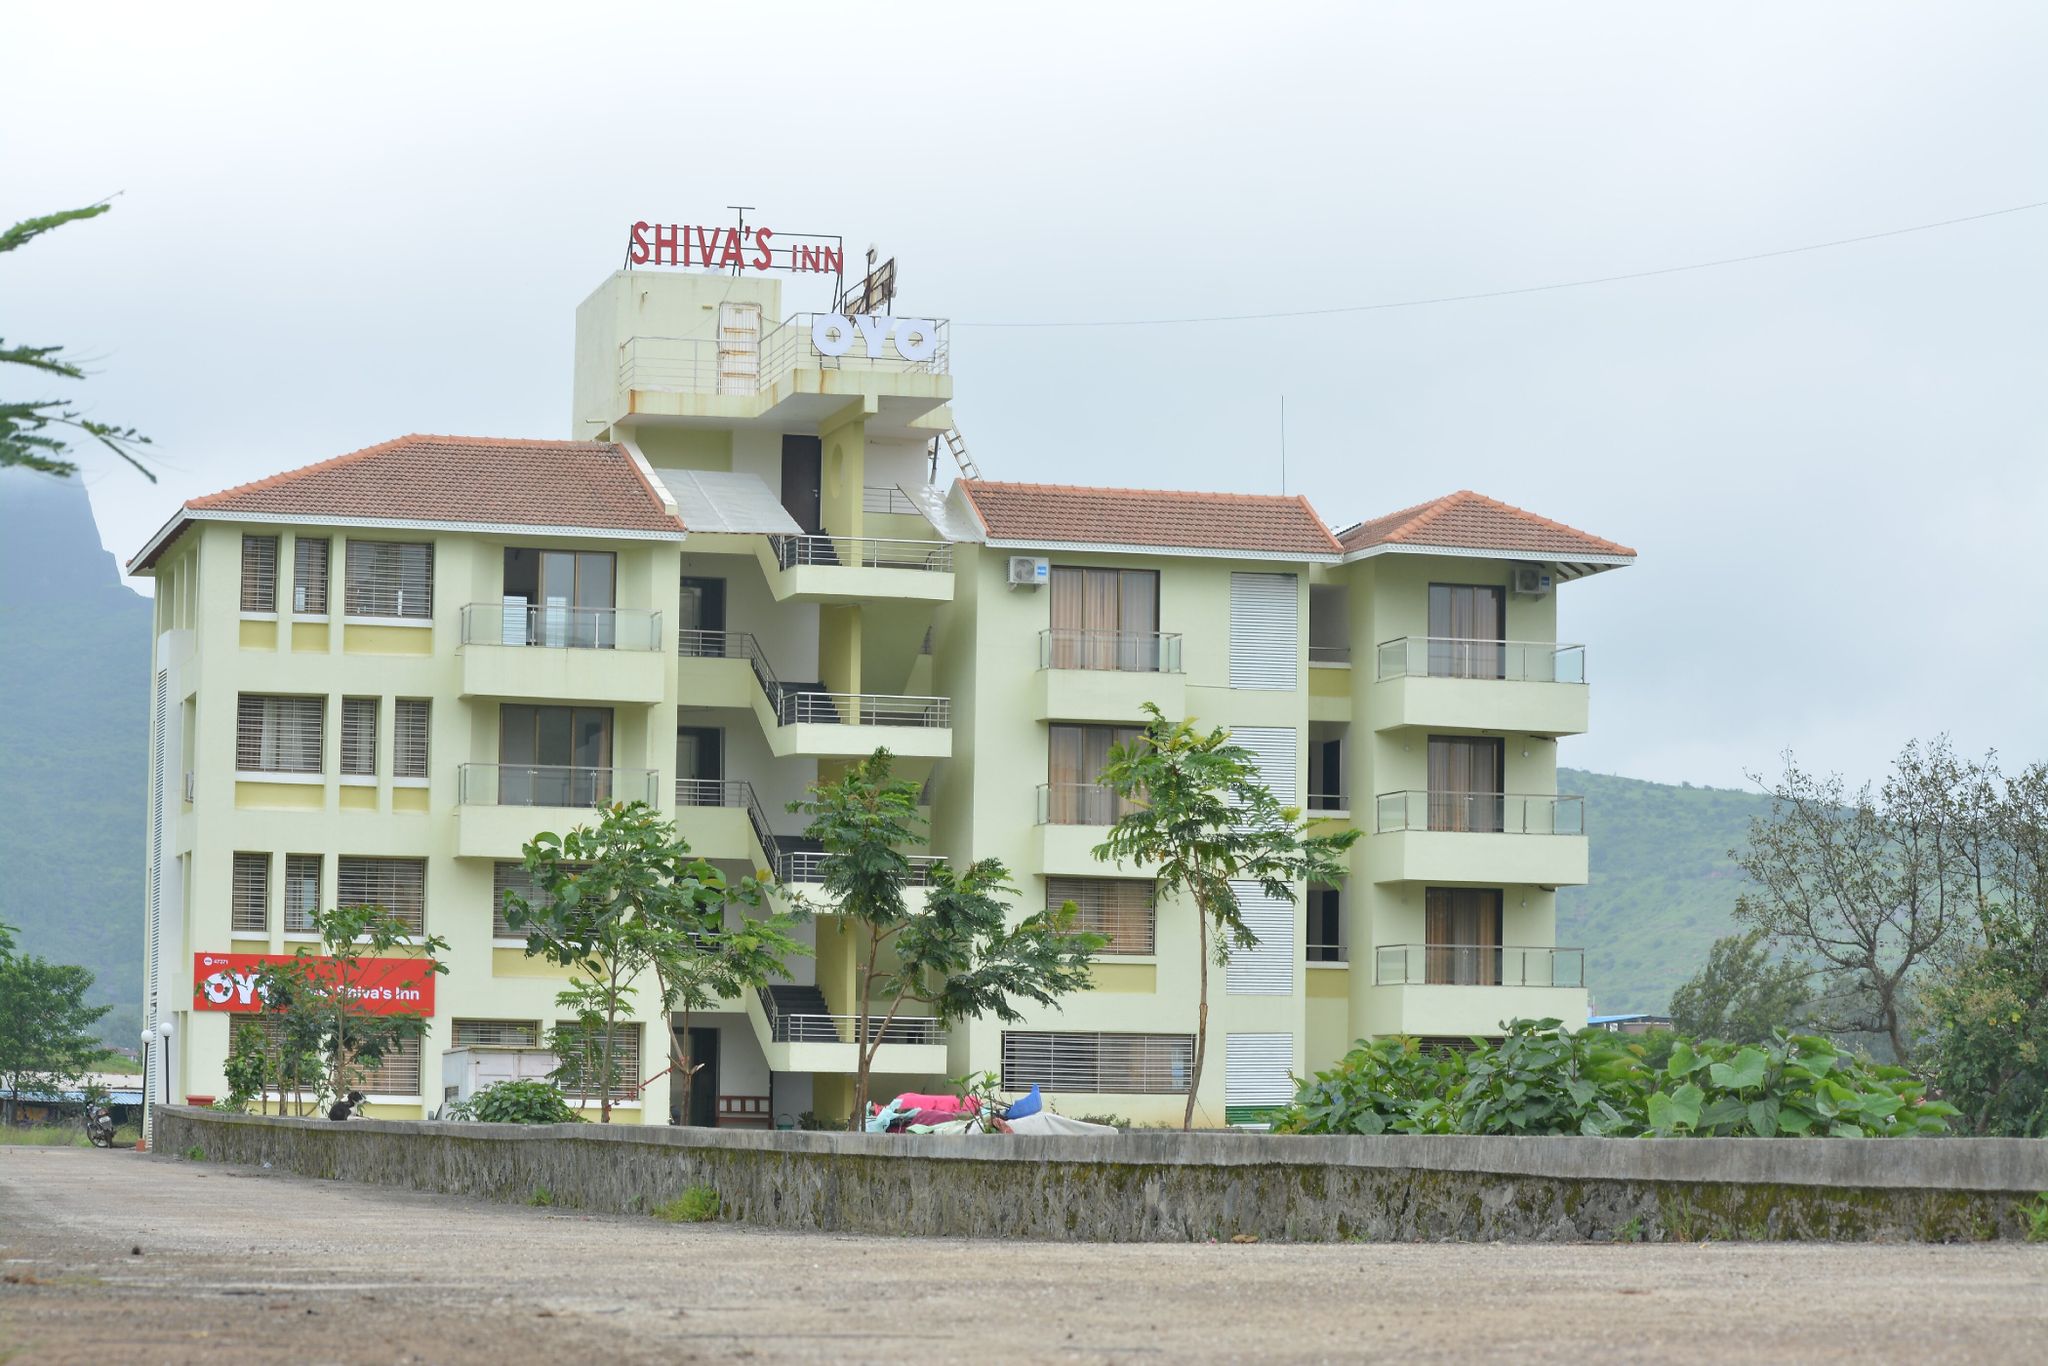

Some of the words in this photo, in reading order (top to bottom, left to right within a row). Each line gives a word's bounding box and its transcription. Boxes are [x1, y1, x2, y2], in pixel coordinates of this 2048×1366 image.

[630, 220, 774, 271] SHIVA'S
[791, 244, 843, 275] INN
[811, 313, 937, 362] OYO
[395, 986, 420, 1000] Inn
